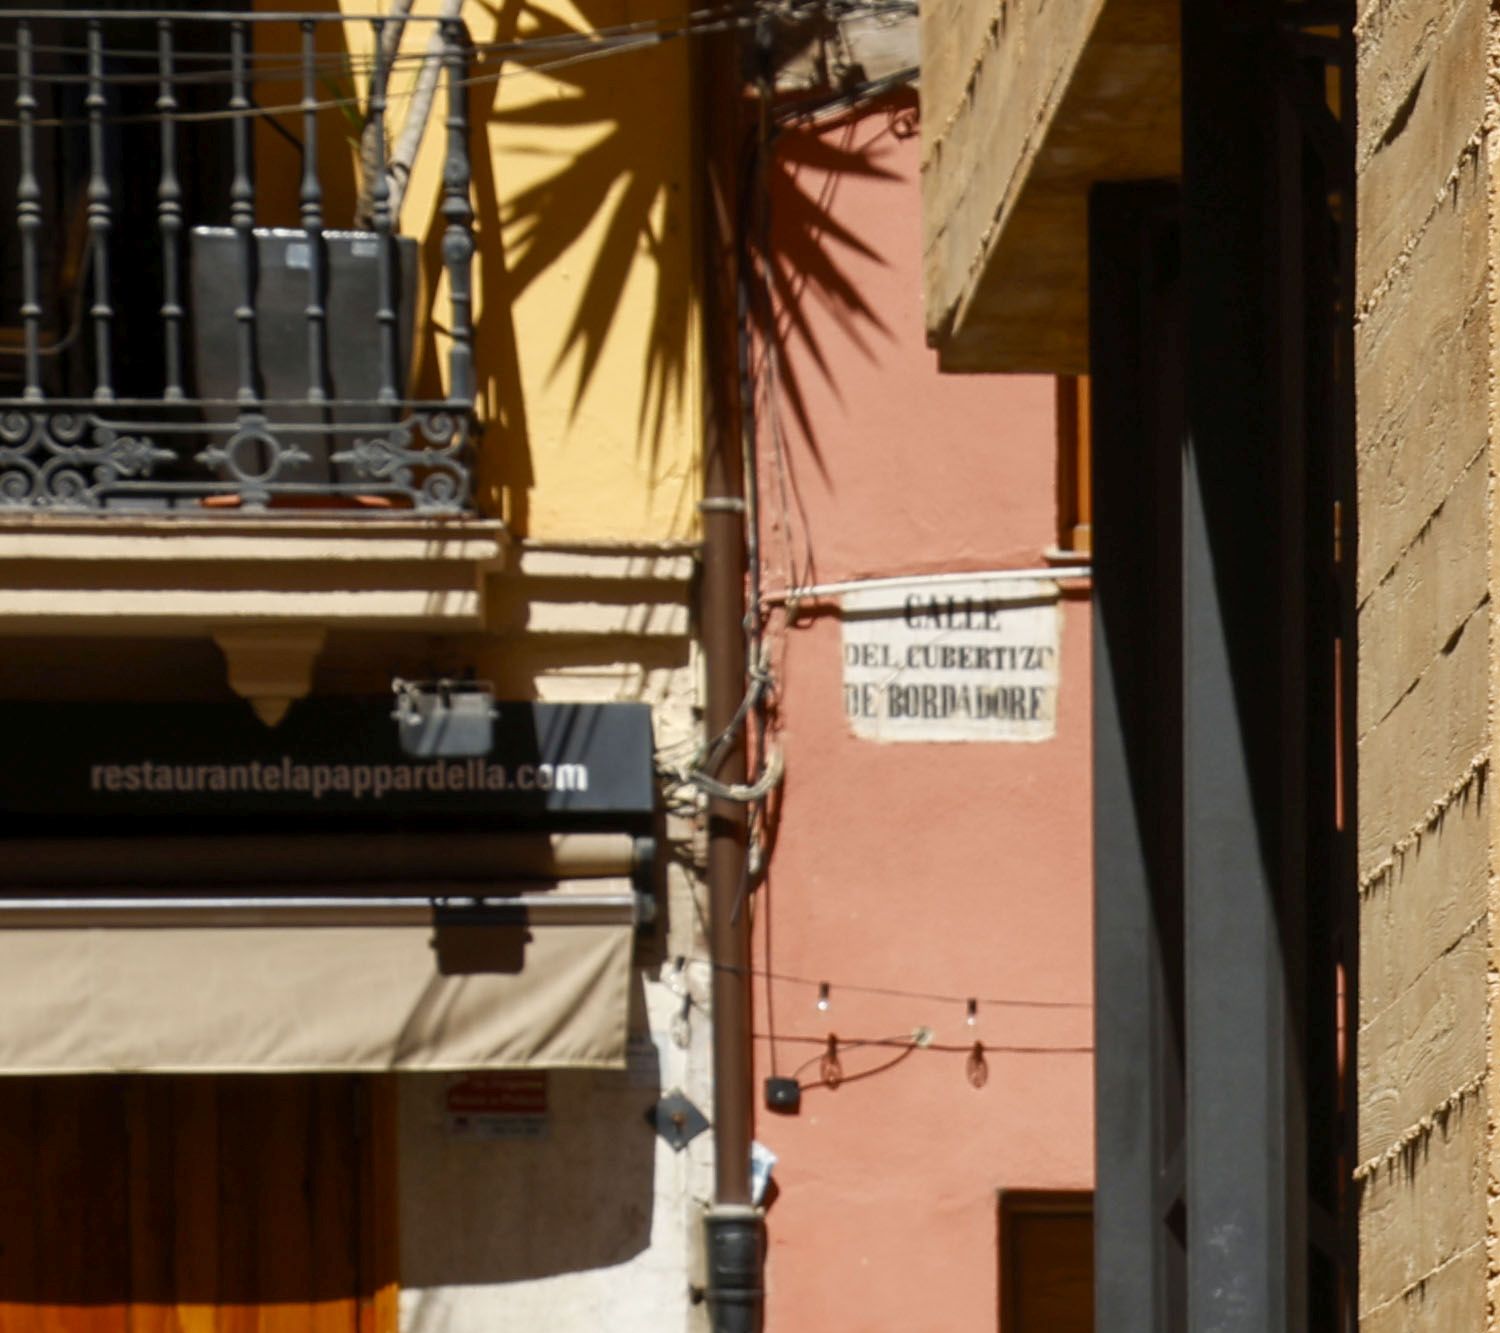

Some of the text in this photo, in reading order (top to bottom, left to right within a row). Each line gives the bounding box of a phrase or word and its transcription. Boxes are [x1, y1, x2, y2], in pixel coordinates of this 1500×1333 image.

[903, 593, 1002, 632] CALLE
[844, 642, 898, 669] DEL
[91, 757, 589, 797] restaurantelapappardella.com
